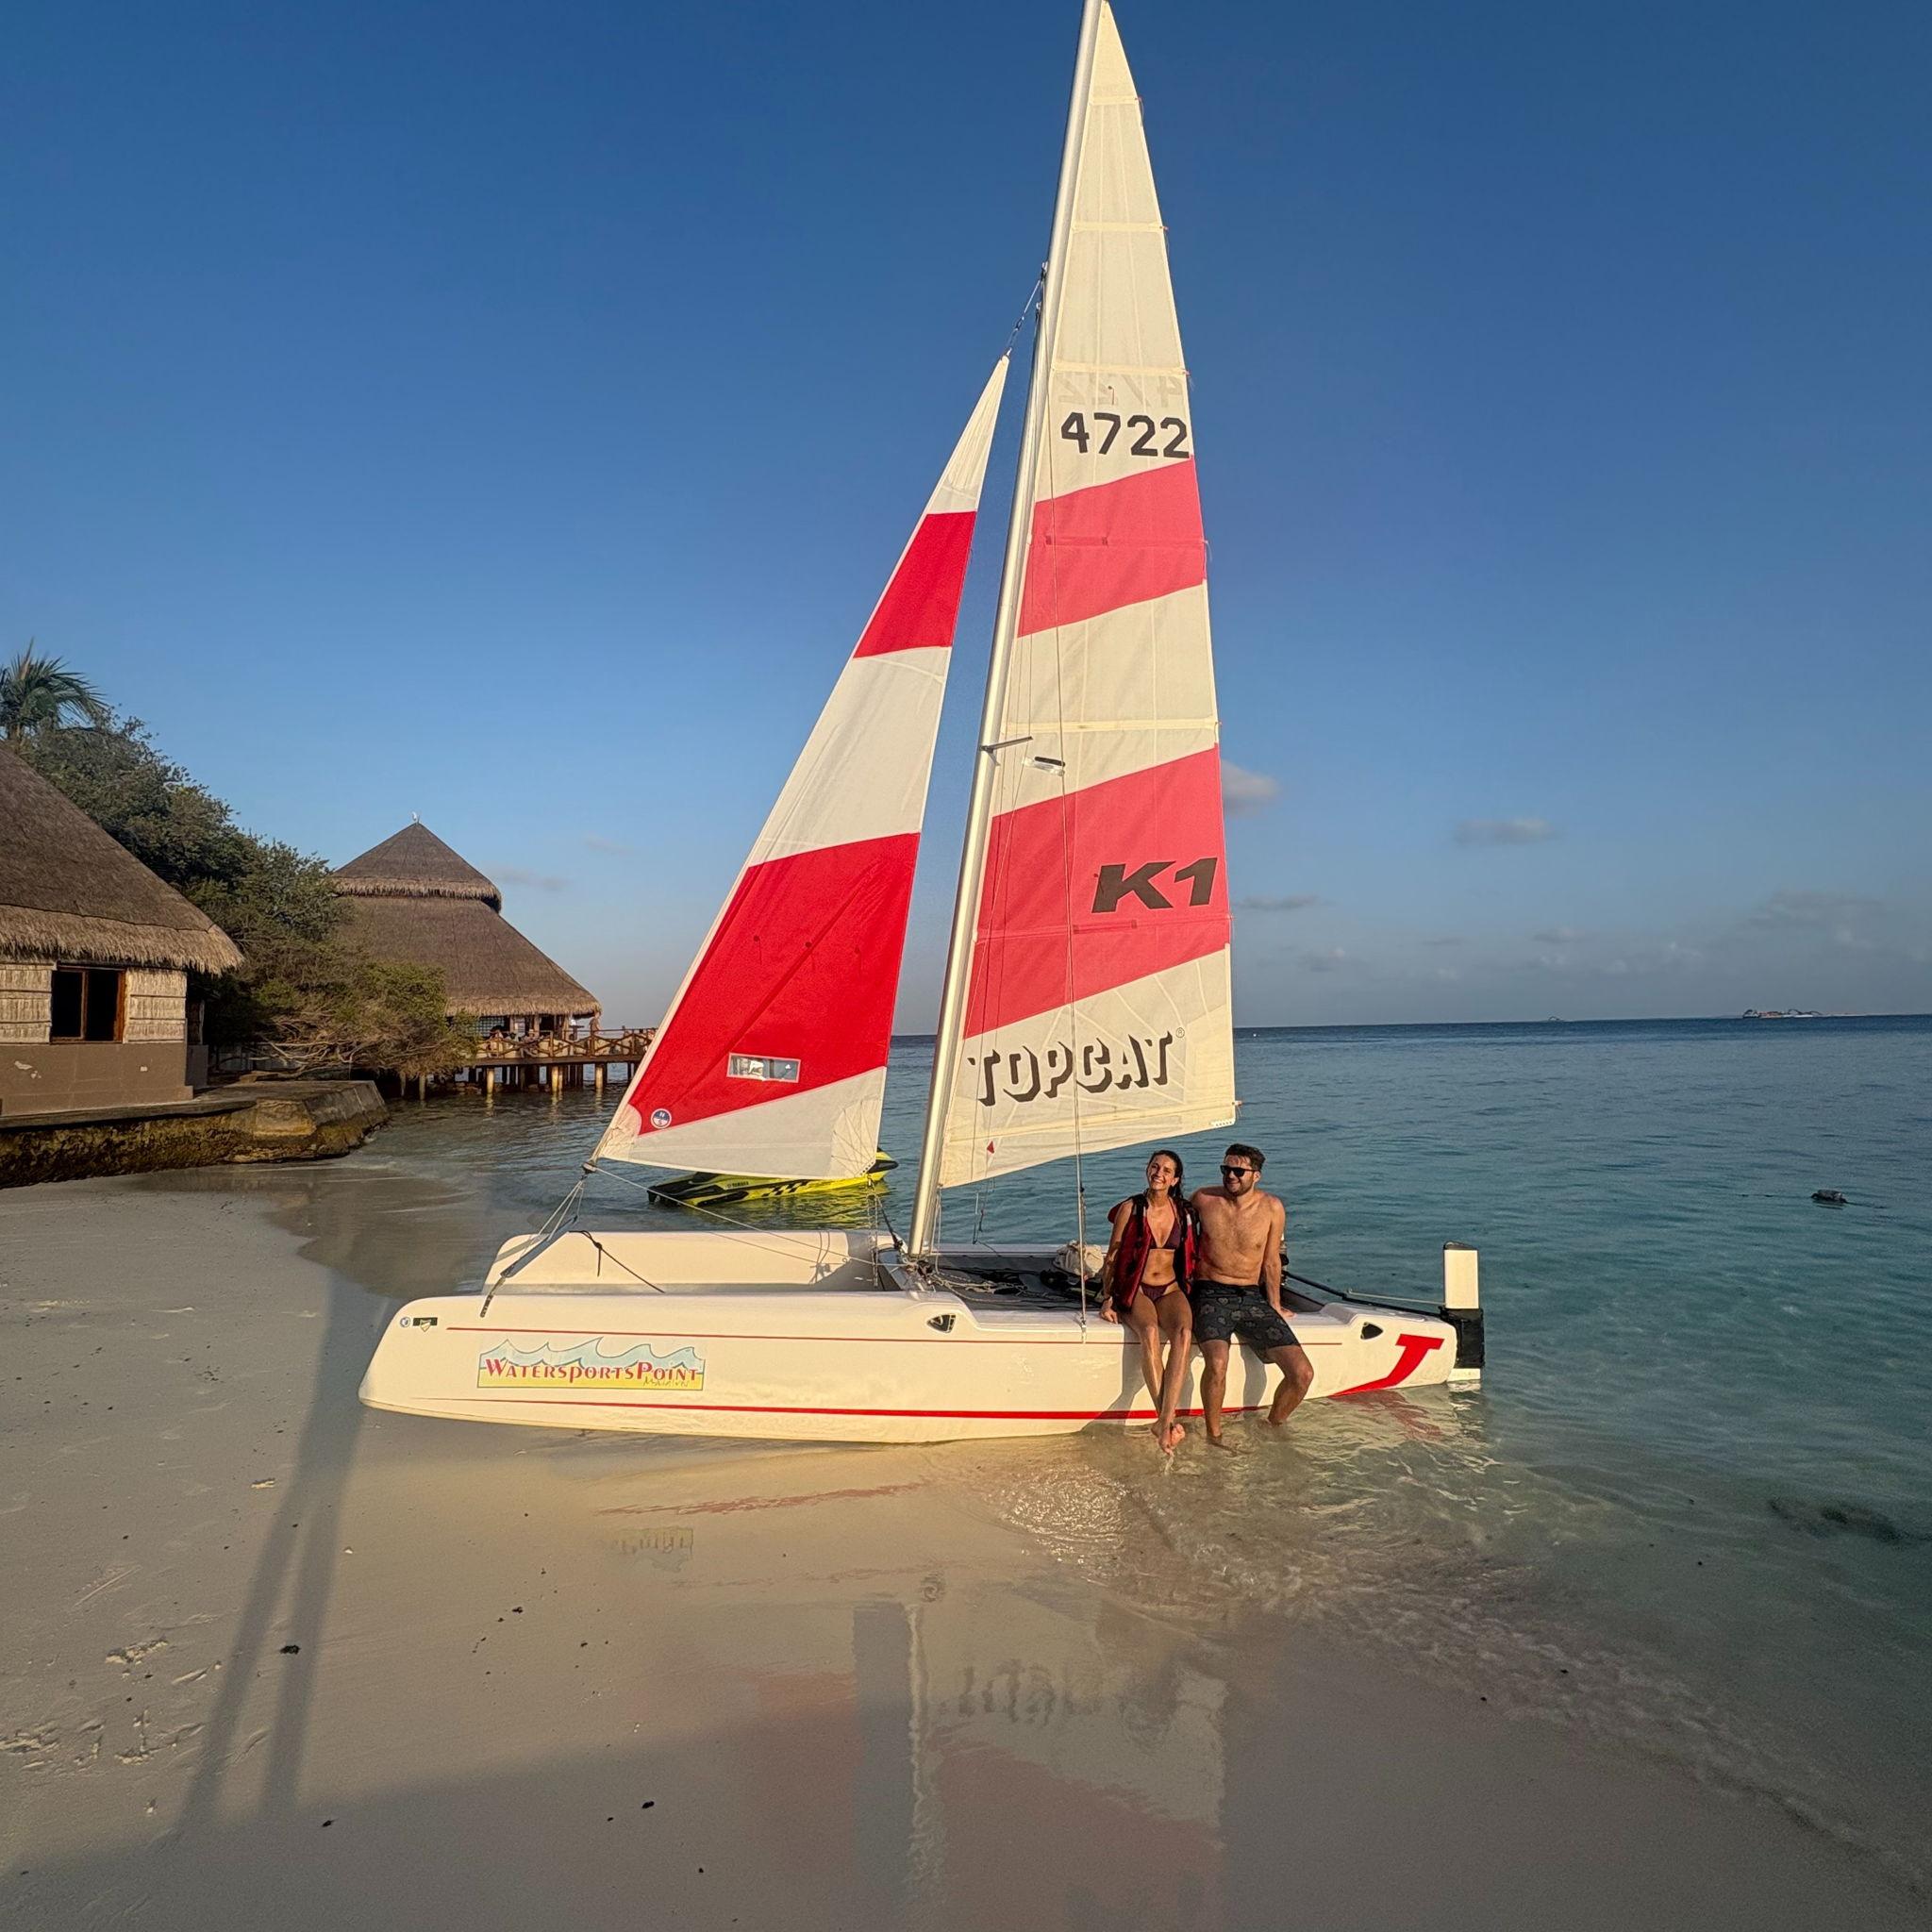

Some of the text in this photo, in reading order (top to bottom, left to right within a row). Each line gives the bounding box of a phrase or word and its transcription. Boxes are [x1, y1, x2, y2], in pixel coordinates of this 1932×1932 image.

[1060, 411, 1191, 459] 4722
[1091, 857, 1218, 914] K1
[967, 1030, 1174, 1108] TOPCAT
